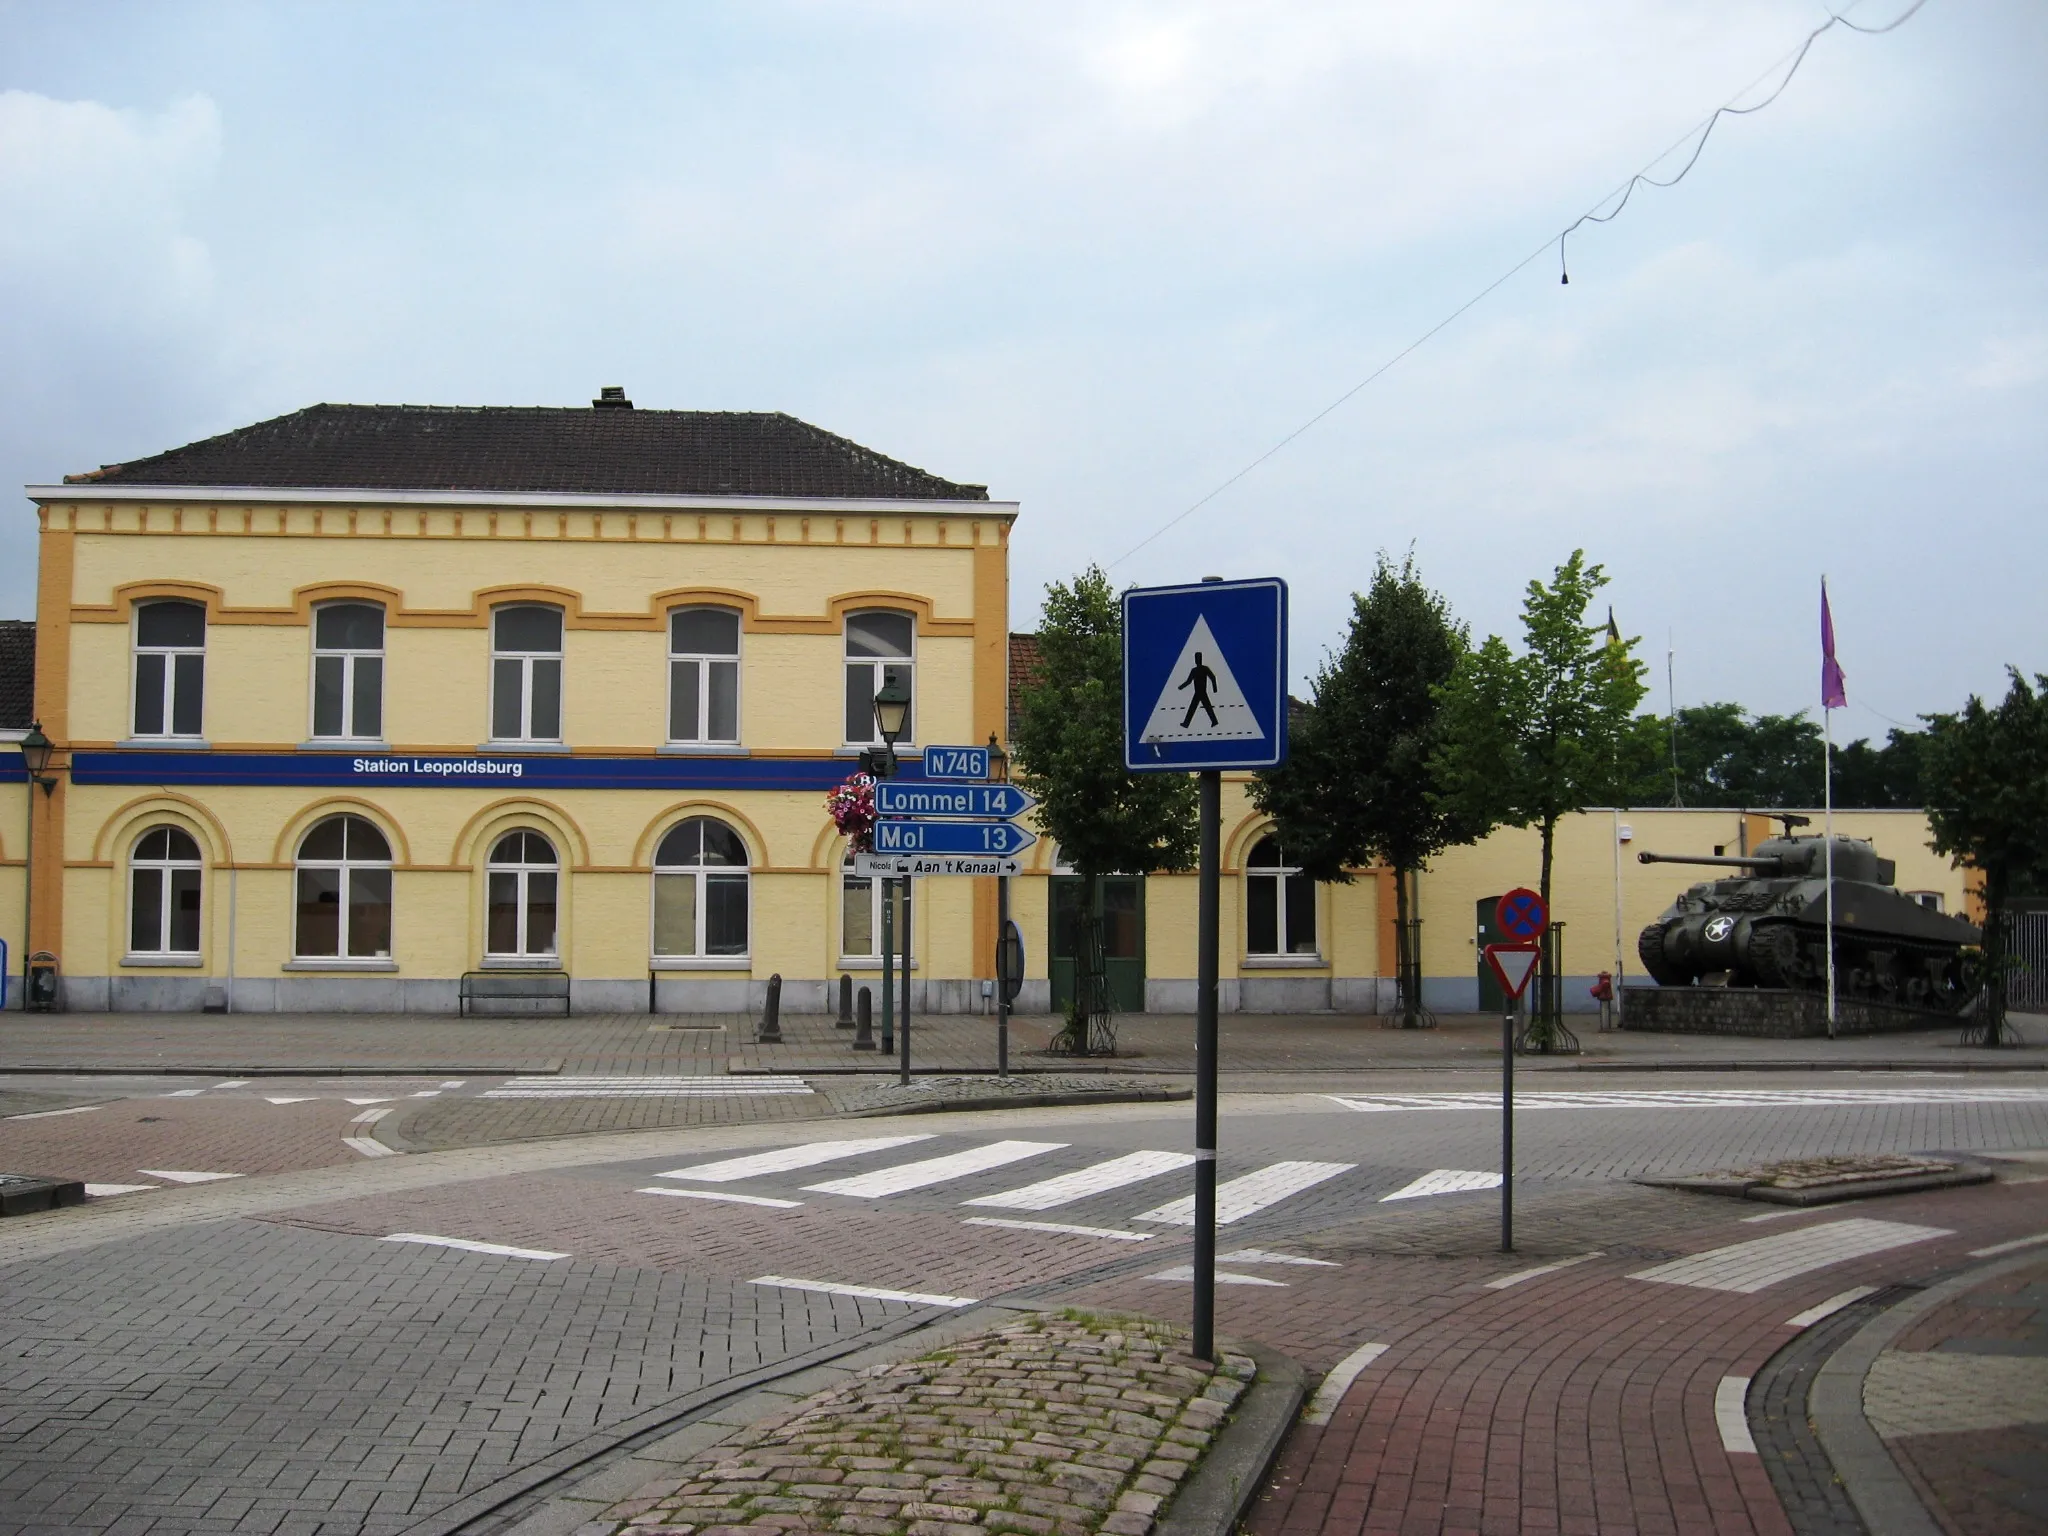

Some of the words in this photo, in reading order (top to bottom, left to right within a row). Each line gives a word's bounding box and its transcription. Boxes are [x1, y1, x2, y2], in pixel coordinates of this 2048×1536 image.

[353, 758, 408, 773] Station
[413, 759, 523, 777] Leopoldsburg
[932, 752, 982, 774] N746
[881, 788, 974, 811] Lommel
[983, 791, 1007, 812] 14
[881, 826, 924, 848] Mol
[983, 828, 1007, 850] 13
[914, 860, 940, 873] Aan
[945, 861, 952, 873] 't
[955, 861, 1001, 873] Kanaal
